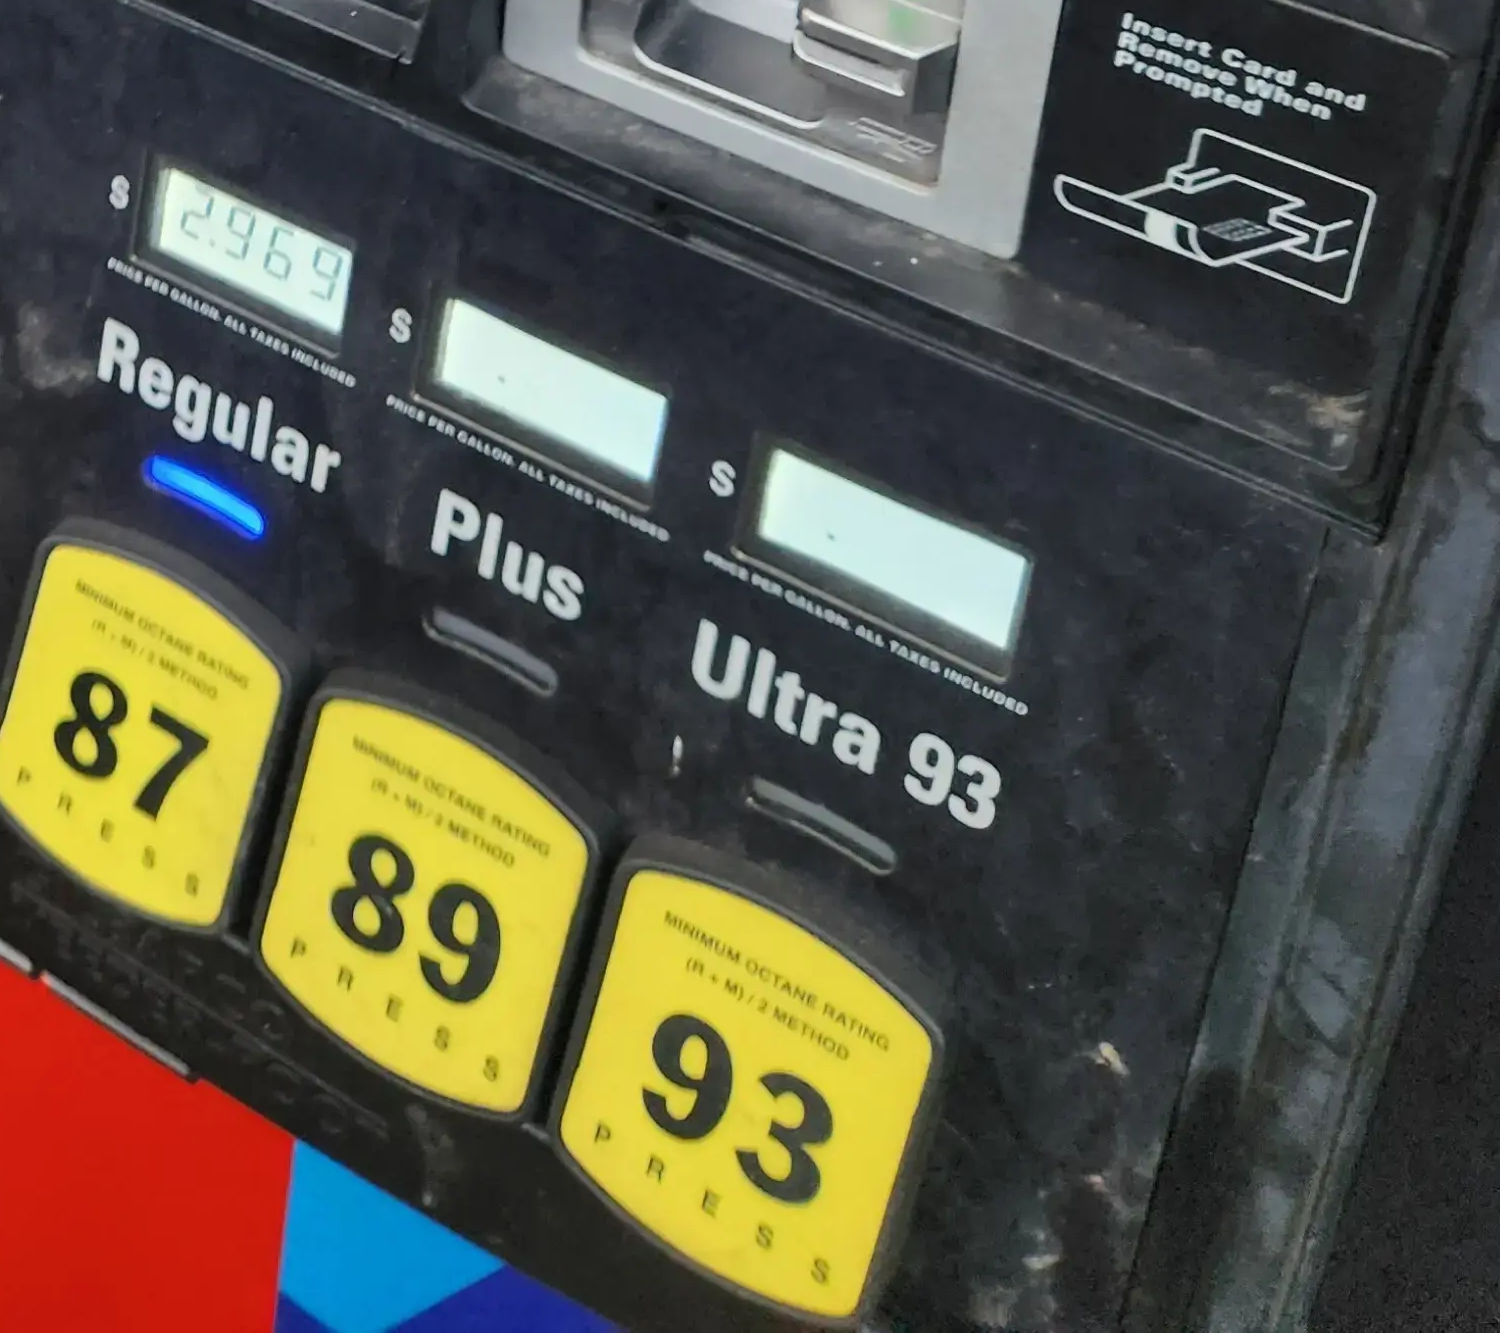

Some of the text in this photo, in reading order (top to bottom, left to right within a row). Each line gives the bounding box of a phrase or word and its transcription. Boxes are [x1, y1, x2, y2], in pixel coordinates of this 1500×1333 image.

[1113, 48, 1264, 117] Prompted
[1117, 30, 1333, 121] Remove When
[1120, 11, 1367, 112] Insert Card and
[107, 256, 143, 284] PRICE
[144, 274, 169, 297] PER
[223, 314, 248, 336] ALL
[250, 325, 289, 356] TAXES
[291, 347, 357, 389] INCLUDED
[95, 316, 342, 493] Regular
[385, 393, 426, 423] PRICE
[427, 414, 456, 438] PER
[518, 460, 545, 483] ALL
[549, 473, 595, 506] TAXES
[595, 497, 672, 543] INCLUDED
[430, 487, 585, 621] Plus
[74, 578, 250, 691] MINIMUM OCTANE RATING
[159, 656, 218, 701] METHOD
[703, 549, 749, 582] PRICE
[751, 571, 784, 598] PER
[854, 623, 886, 648] ALL
[888, 638, 941, 674] TAXES
[943, 666, 1030, 716] INCLUDED
[53, 671, 209, 822] 87
[691, 617, 1002, 830] Ultra 93
[352, 734, 551, 858] MINIMUM OCTANE RATING
[447, 819, 516, 869] METHOD
[330, 833, 501, 1004] 89
[662, 909, 891, 1053] MINIMUM OCTANE RATING
[772, 1004, 850, 1062] METHOD
[641, 1013, 834, 1207] 93
